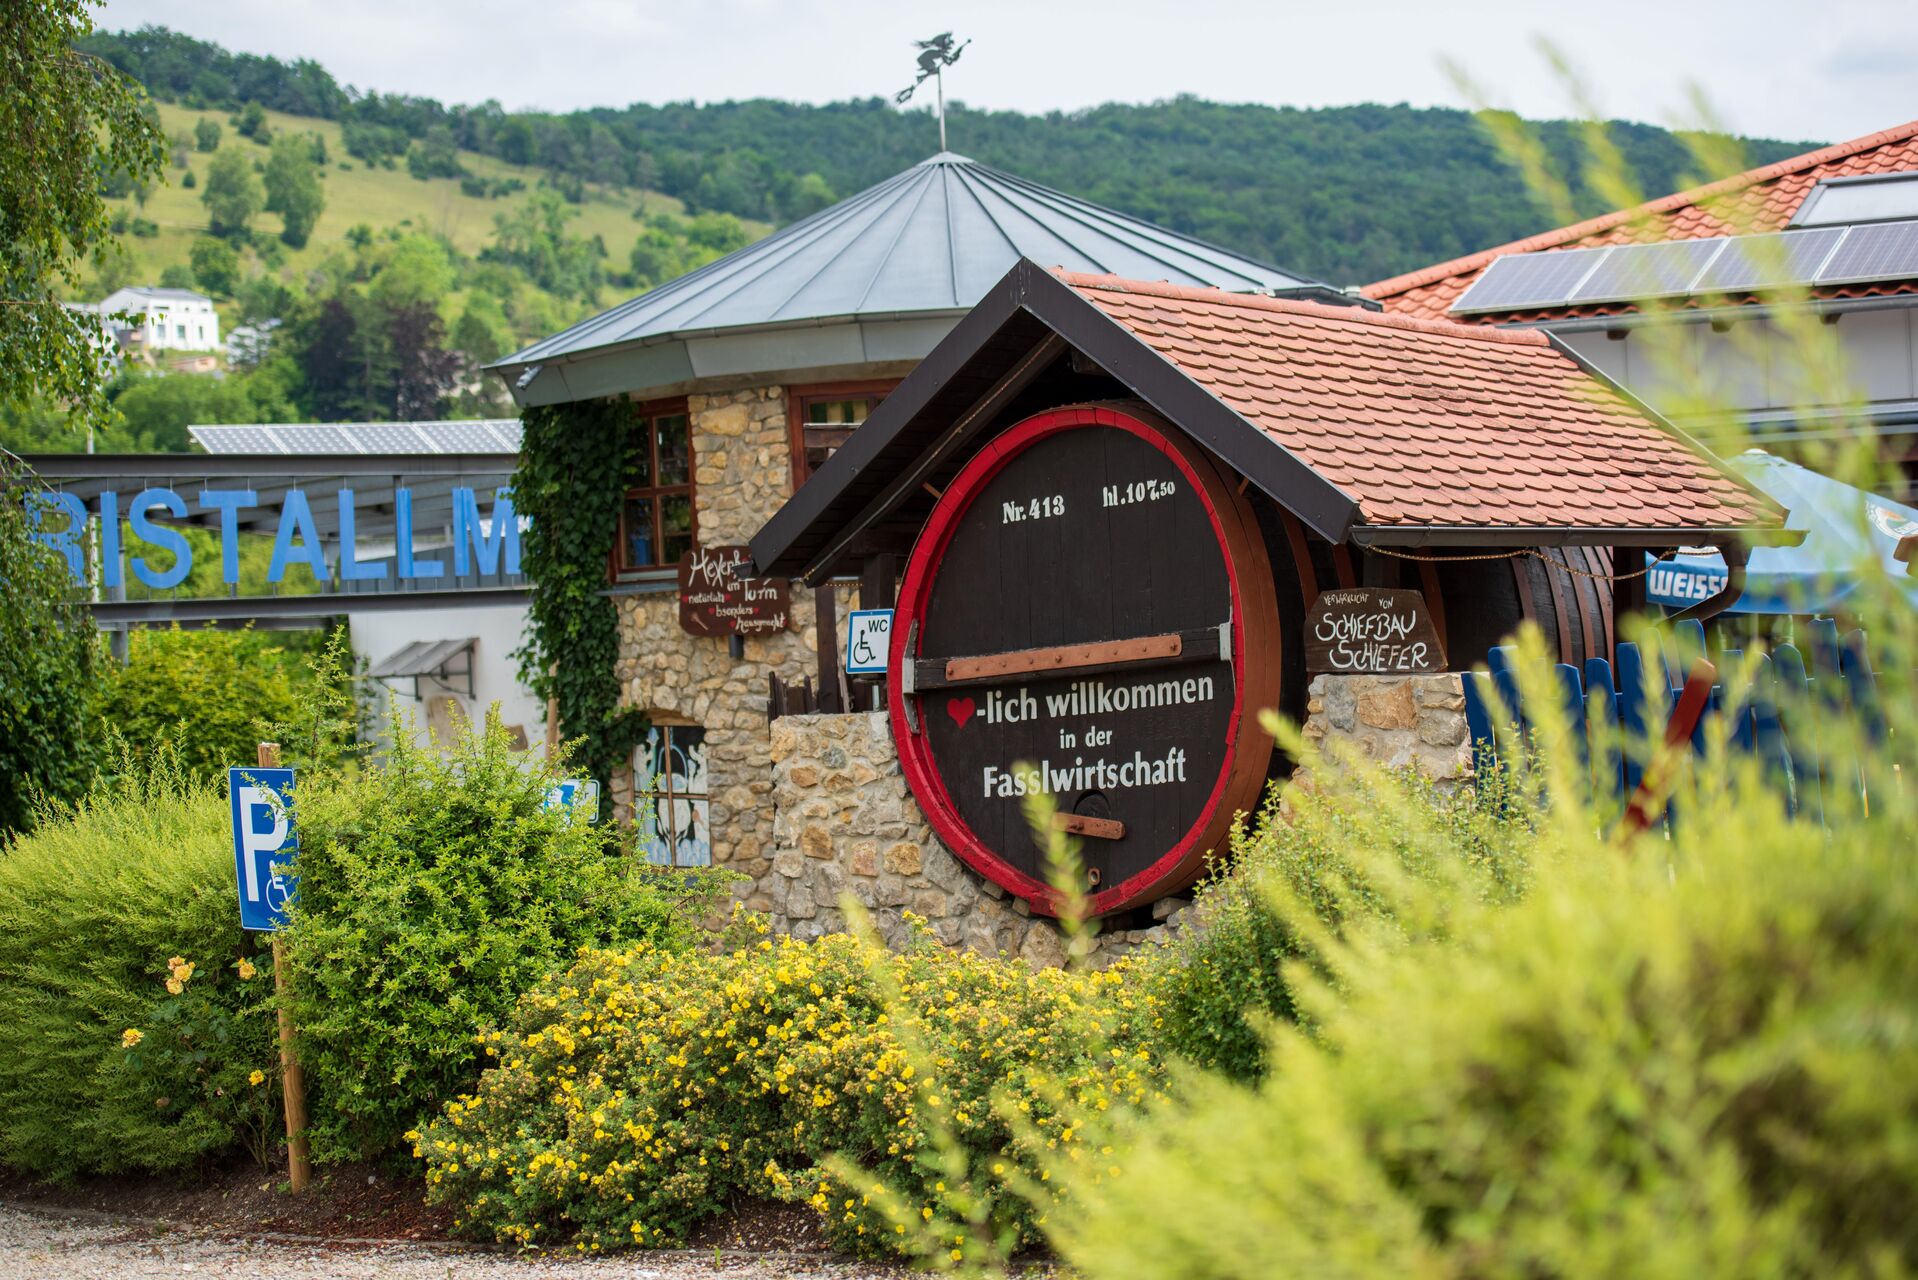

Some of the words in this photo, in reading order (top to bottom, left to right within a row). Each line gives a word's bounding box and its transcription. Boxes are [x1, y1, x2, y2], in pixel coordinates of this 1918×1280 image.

[738, 578, 778, 601] Turm
[1378, 596, 1394, 609] VON
[868, 619, 888, 632] WC
[1315, 610, 1416, 641] SCHIEFBAU
[1329, 639, 1429, 671] SCHIEFER
[1046, 676, 1214, 718] willkommen
[1060, 728, 1077, 749] in
[1085, 726, 1113, 747] der
[983, 746, 1187, 798] Fasslwirtschaft
[239, 786, 288, 902] P
